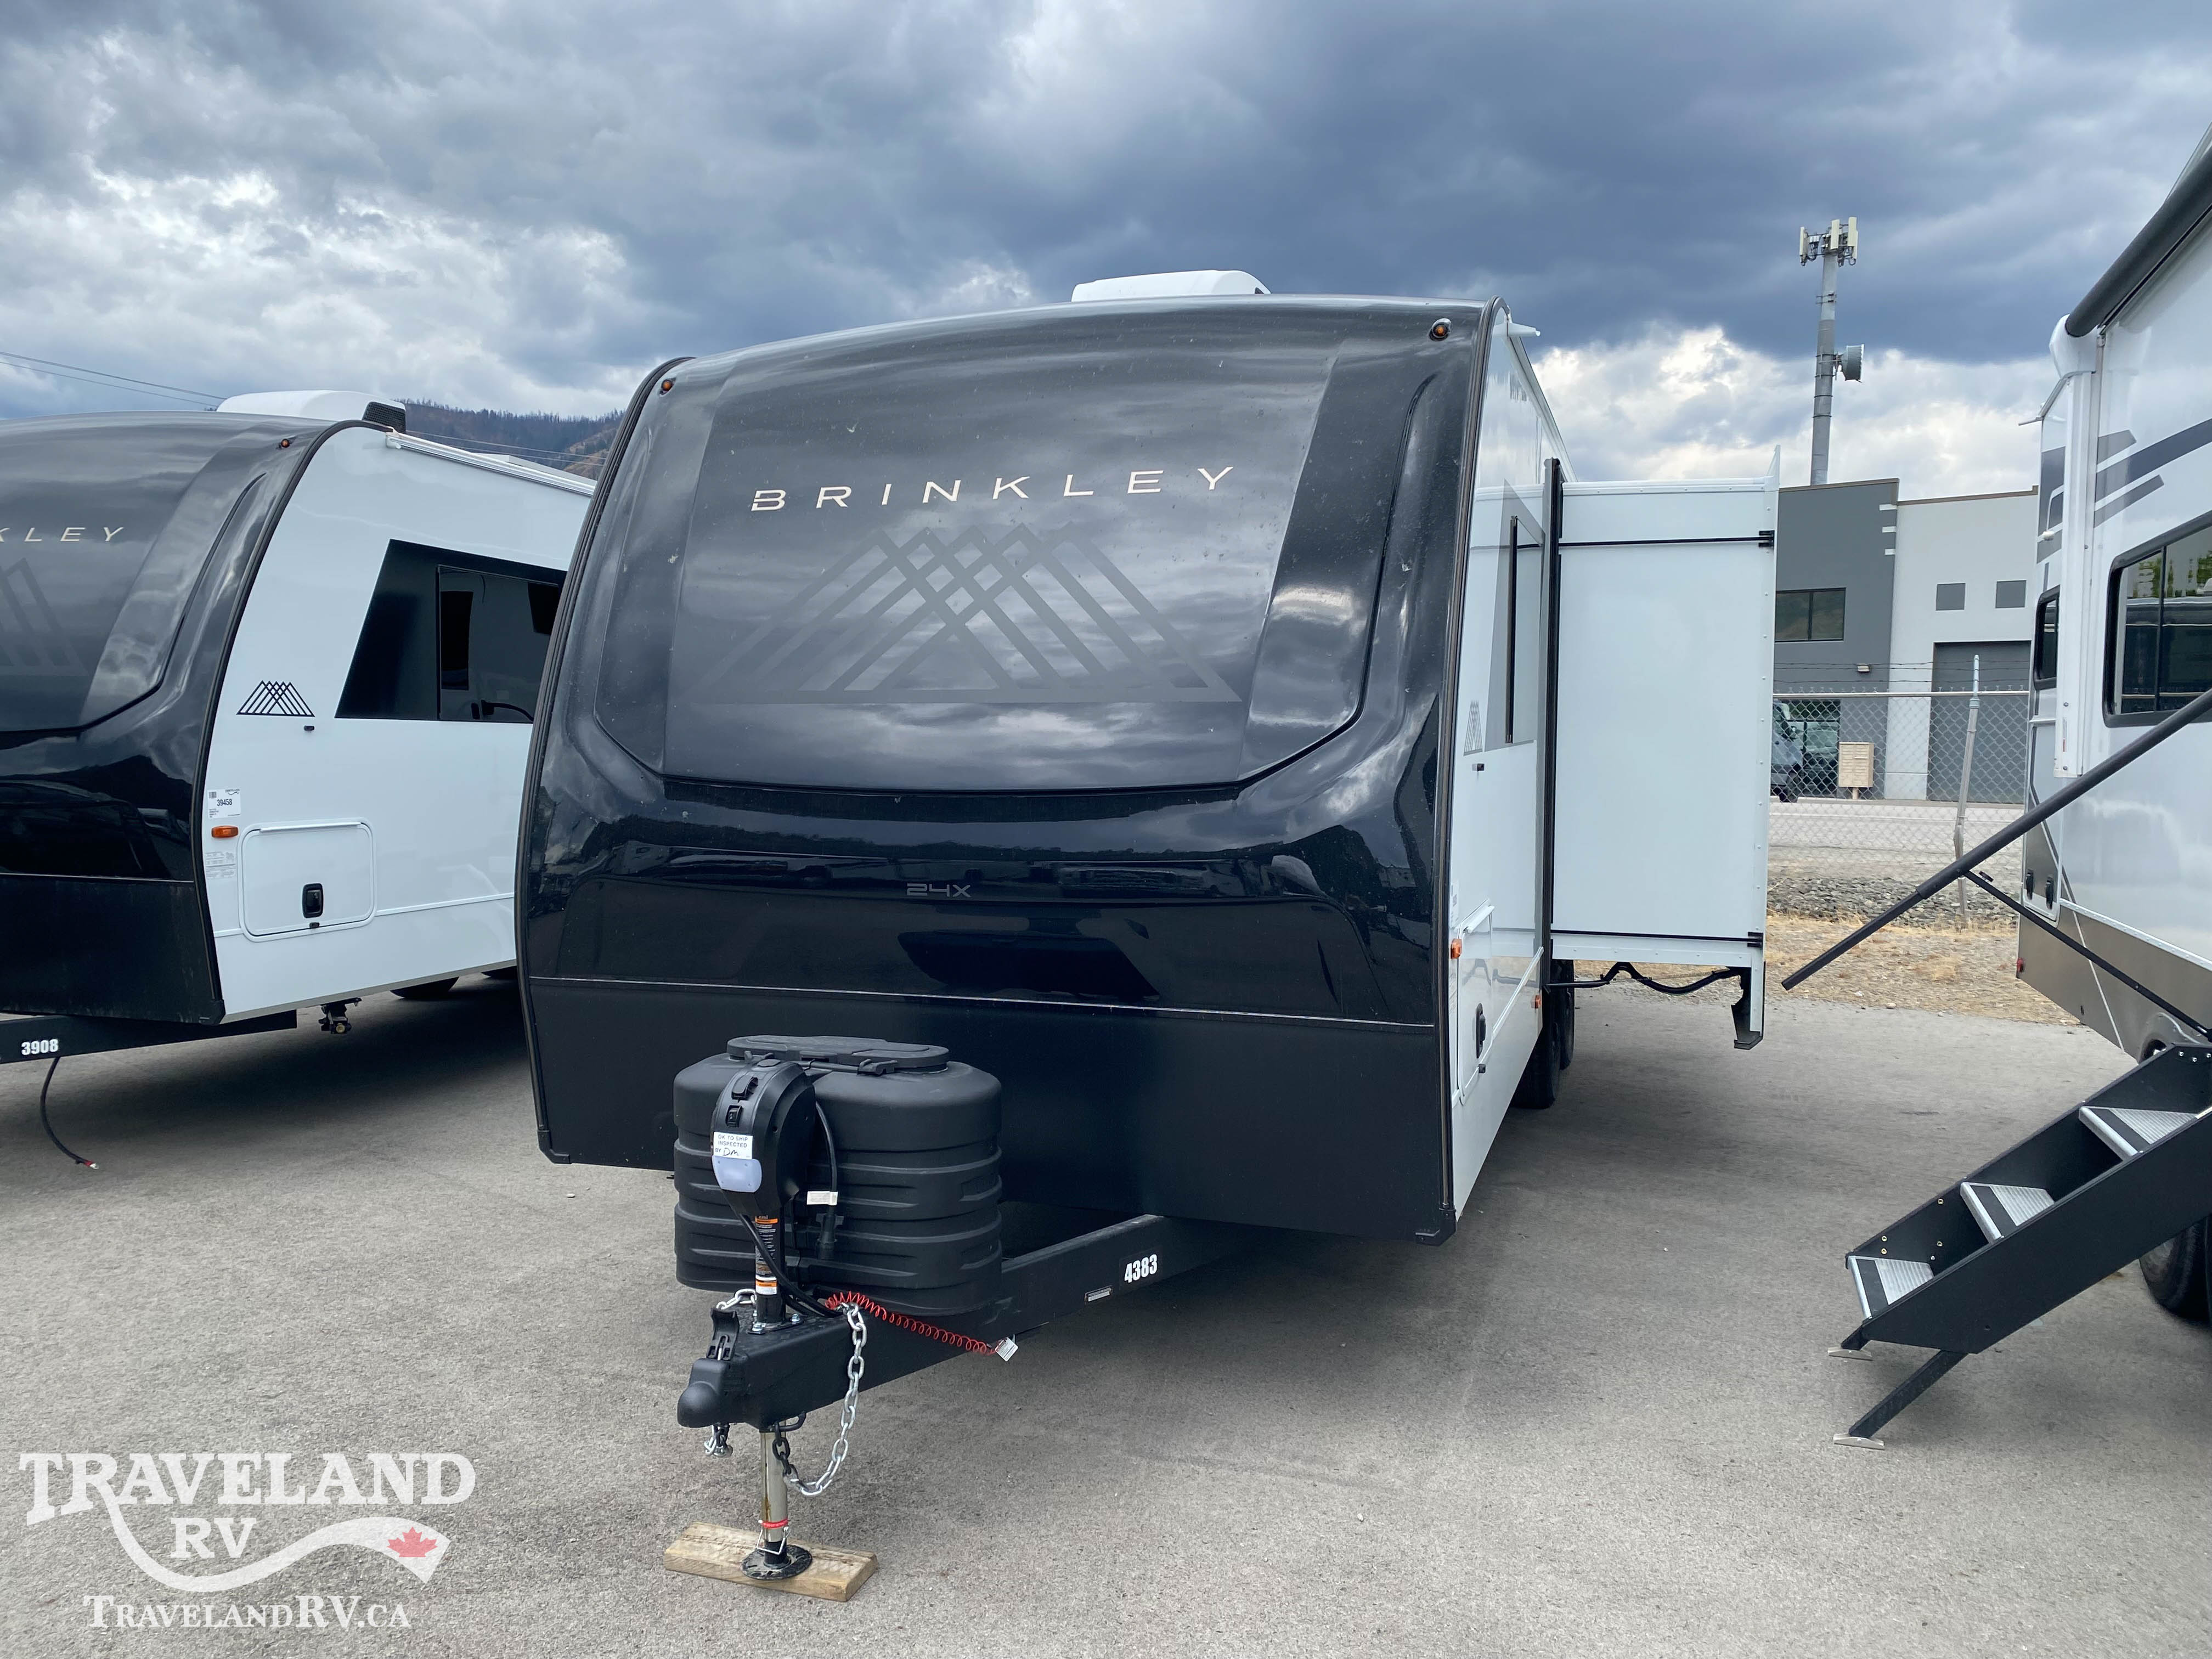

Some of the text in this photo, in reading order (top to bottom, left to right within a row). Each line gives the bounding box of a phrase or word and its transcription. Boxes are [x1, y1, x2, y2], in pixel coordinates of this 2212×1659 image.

[751, 466, 1234, 511] BRINKLEY
[217, 798, 233, 806] 39458
[907, 883, 972, 898] 24X
[21, 1039, 59, 1056] 3908
[1124, 1254, 1158, 1283] 4383
